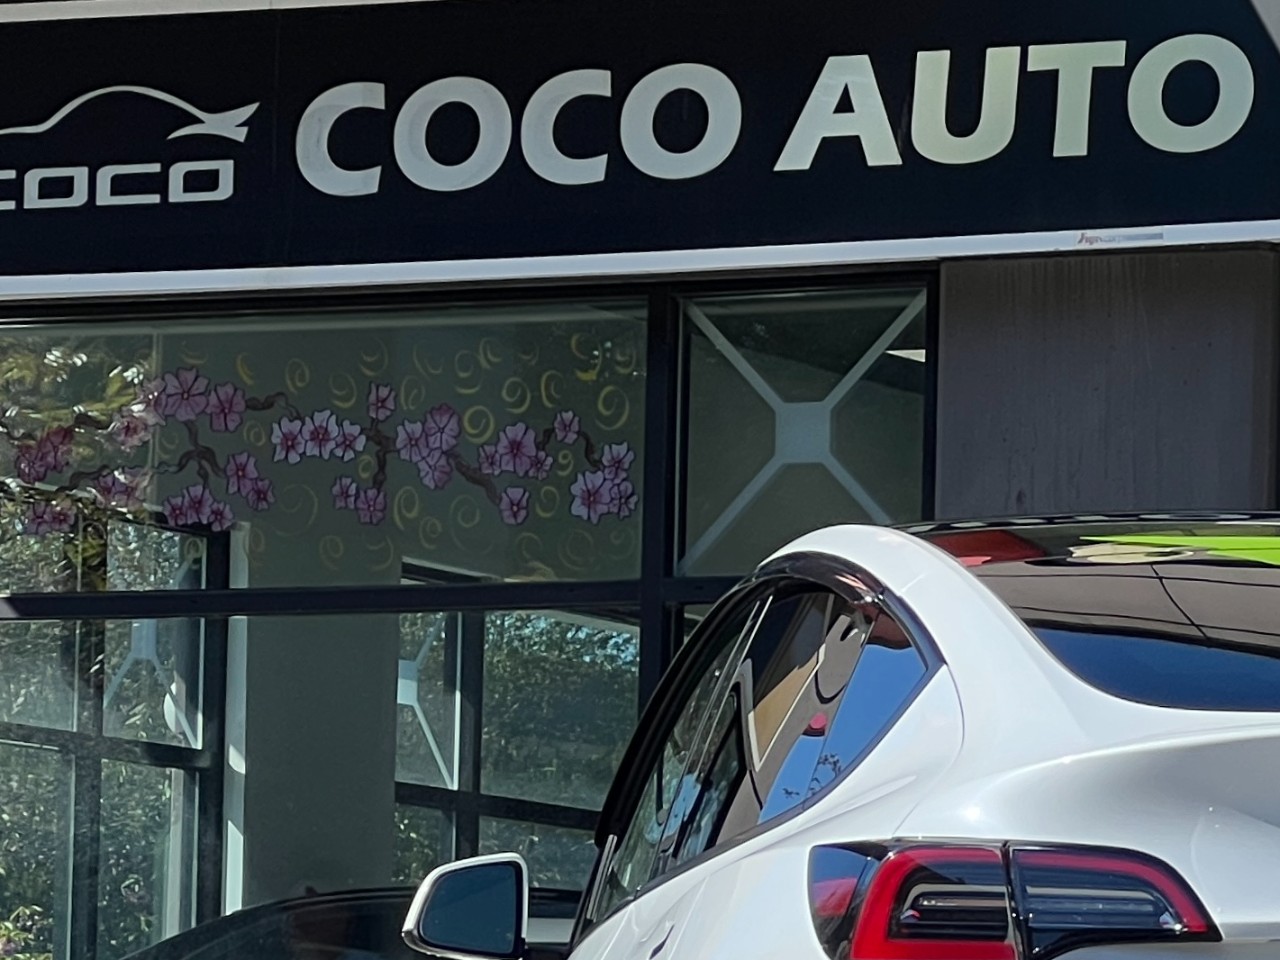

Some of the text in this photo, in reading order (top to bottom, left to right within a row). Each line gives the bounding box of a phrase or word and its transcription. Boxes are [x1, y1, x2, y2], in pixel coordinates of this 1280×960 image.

[295, 33, 1255, 197] COCO AUTO
[0, 159, 234, 210] OCO
